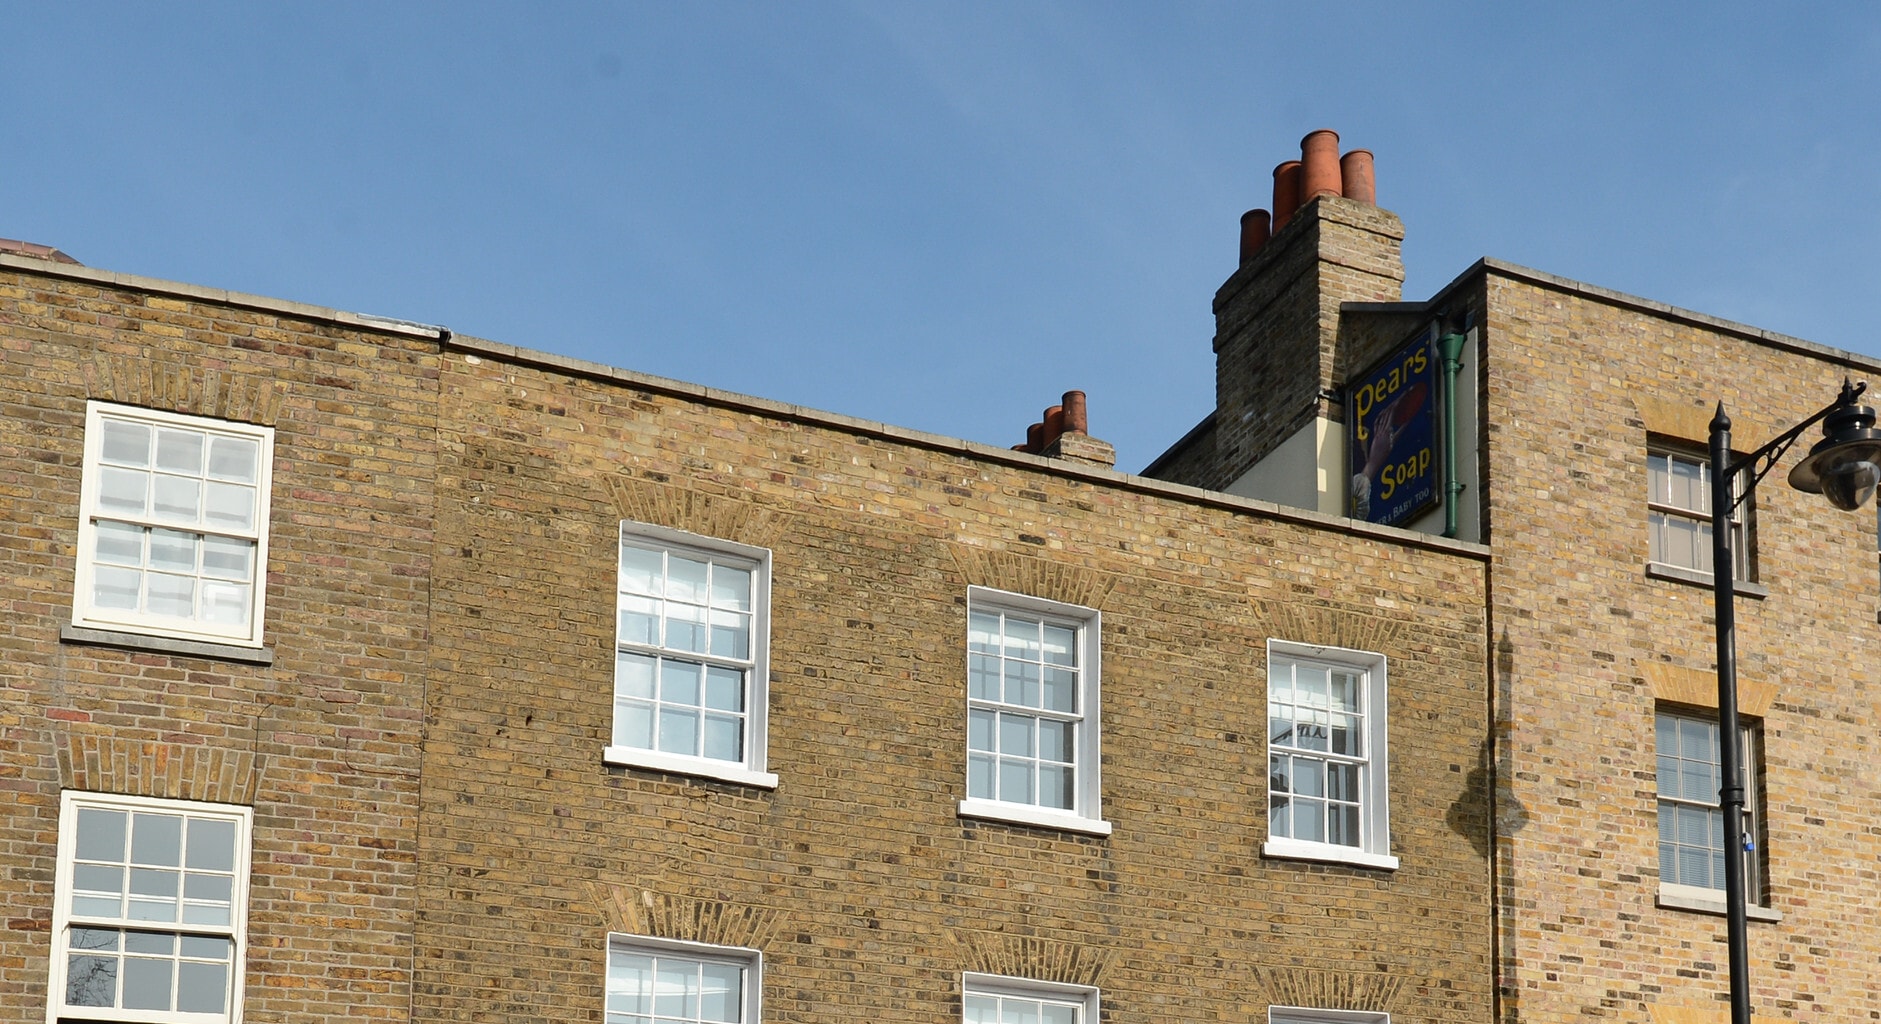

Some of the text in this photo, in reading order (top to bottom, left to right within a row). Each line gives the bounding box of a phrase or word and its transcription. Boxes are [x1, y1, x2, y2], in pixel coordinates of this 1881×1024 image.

[1380, 447, 1431, 500] Soap
[1393, 499, 1412, 519] BABY
[1414, 487, 1429, 503] TOO
